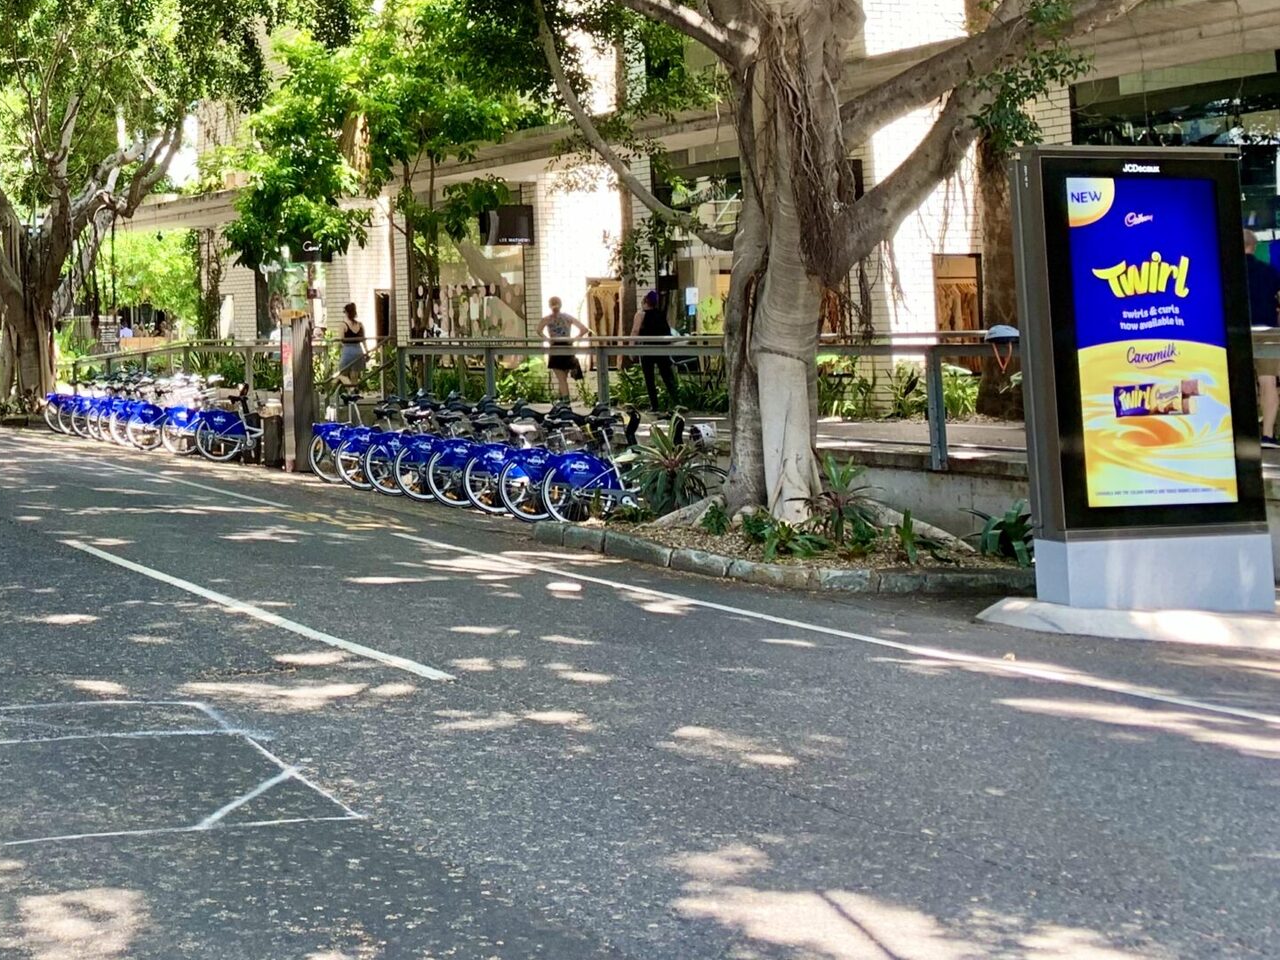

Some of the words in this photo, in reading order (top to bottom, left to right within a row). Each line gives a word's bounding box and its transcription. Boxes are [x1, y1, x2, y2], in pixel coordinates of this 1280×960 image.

[1122, 163, 1161, 173] JCDecaux
[1070, 191, 1102, 204] NEW
[1091, 251, 1190, 298] Twirl
[1122, 308, 1149, 319] swirls
[1149, 306, 1158, 316] &
[1158, 304, 1180, 315] curls
[1120, 321, 1139, 331] now
[1139, 316, 1174, 330] available
[1174, 316, 1185, 326] in
